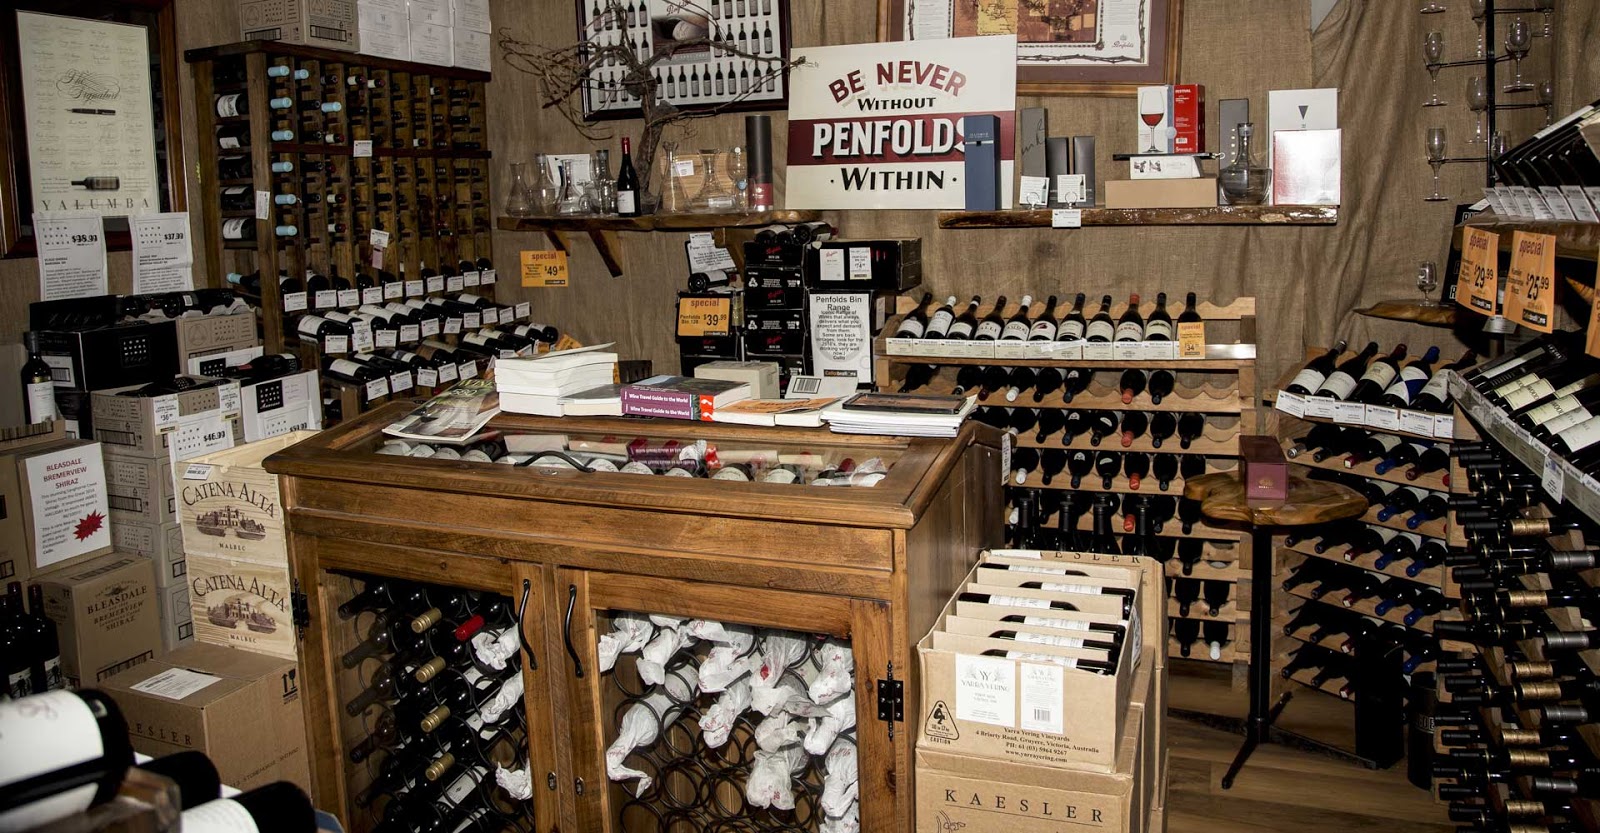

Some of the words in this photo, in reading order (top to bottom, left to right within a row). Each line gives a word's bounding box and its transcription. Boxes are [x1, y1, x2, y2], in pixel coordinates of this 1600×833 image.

[829, 70, 865, 103] BE
[877, 61, 966, 96] NEVER
[42, 198, 150, 211] YALUMBA
[1470, 234, 1489, 250] special
[1520, 240, 1544, 258] special
[532, 252, 556, 261] special
[691, 300, 719, 308] special
[704, 314, 727, 326] $39.99
[46, 458, 82, 472] BLEASDALE
[43, 466, 87, 482] BREMERVIEW
[56, 478, 79, 489] SHIRAZ
[182, 481, 236, 506] CATENA
[239, 482, 274, 518] ALTA
[219, 543, 246, 551] MALBEC
[1040, 551, 1141, 564] ESLER
[88, 585, 147, 614] BLEASDALE
[193, 574, 245, 597] CATENA
[250, 576, 285, 613] ALTA
[106, 615, 135, 631] SHIRAZ
[230, 634, 256, 643] MALBEC
[128, 723, 192, 746] ESLER
[1022, 729, 1040, 738] Yering
[1042, 732, 1070, 742] Vineyards
[1020, 736, 1045, 746] Gruyere,
[1046, 740, 1071, 749] Victoria,
[1072, 745, 1100, 753] Australia
[1005, 750, 1067, 762] www.yarrayering.com
[945, 789, 1103, 822] KAESLER
